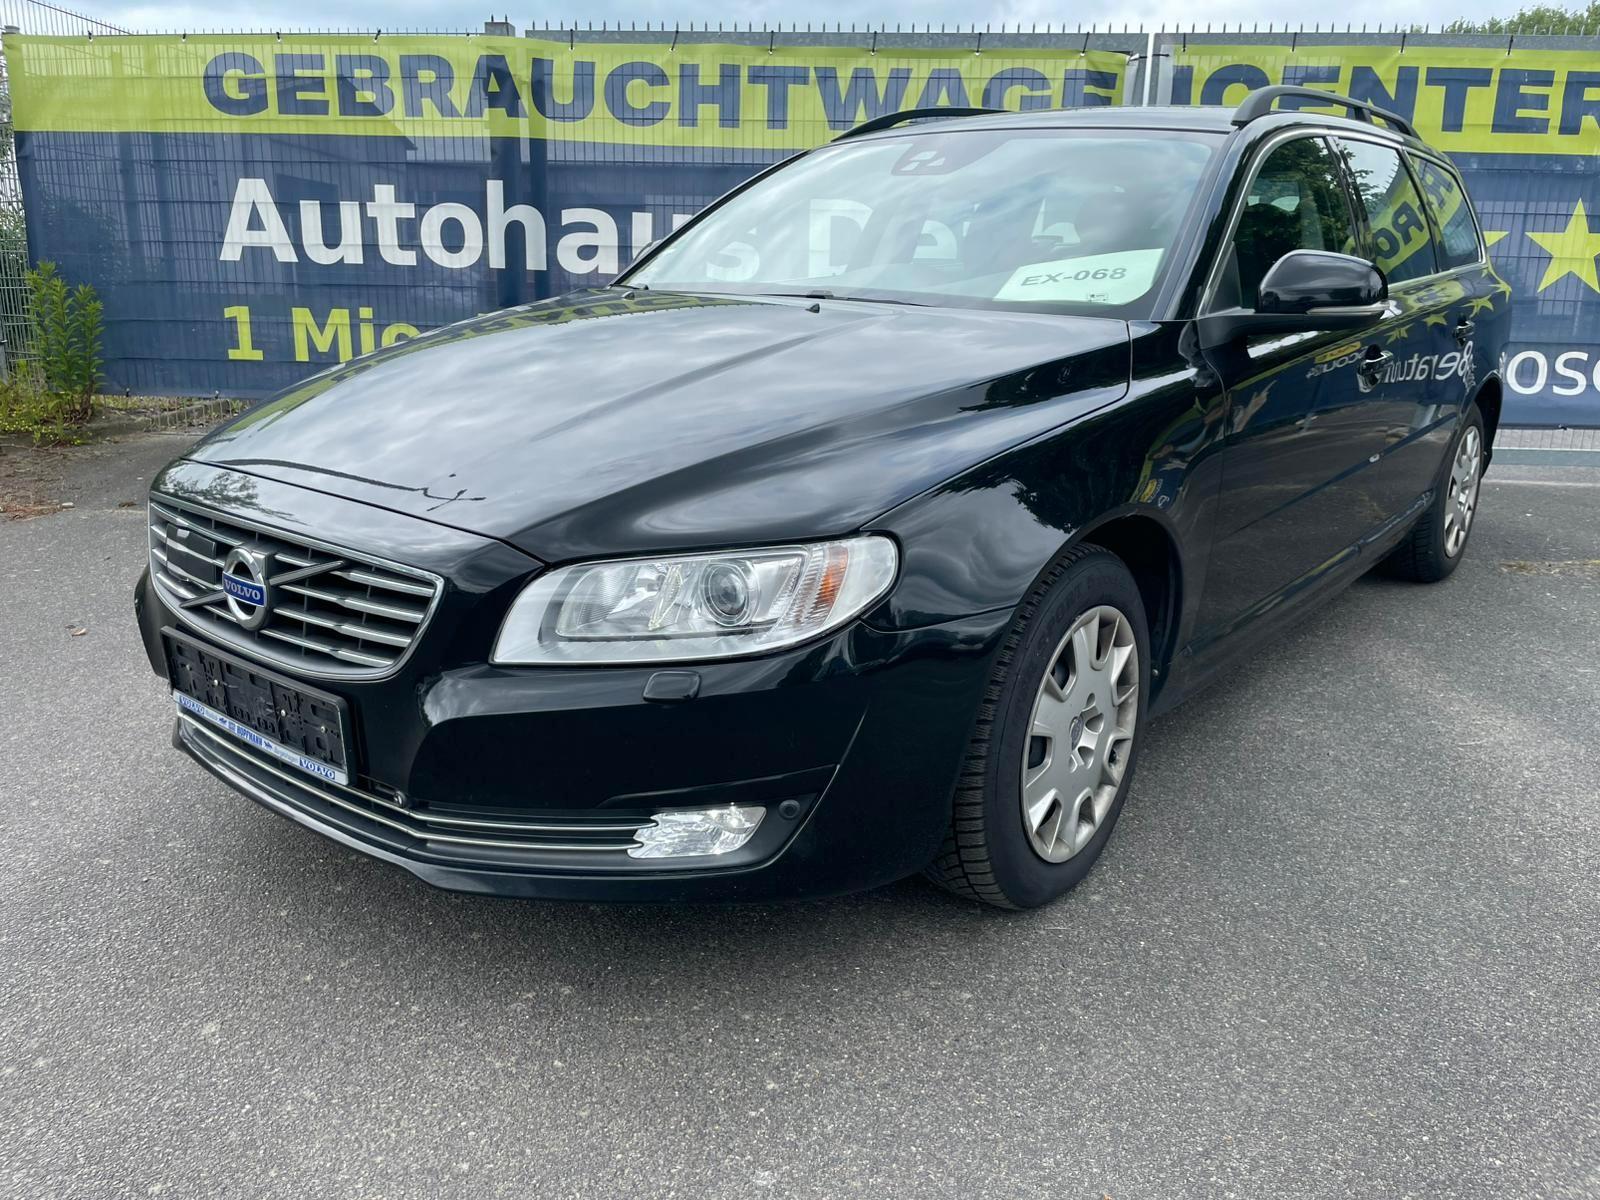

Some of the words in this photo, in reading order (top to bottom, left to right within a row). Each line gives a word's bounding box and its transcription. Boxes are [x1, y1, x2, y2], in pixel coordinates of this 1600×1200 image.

[1020, 267, 1127, 287] EX-068
[223, 306, 264, 361] 1
[224, 579, 262, 601] VOLVO
[301, 760, 335, 779] VOLVO
